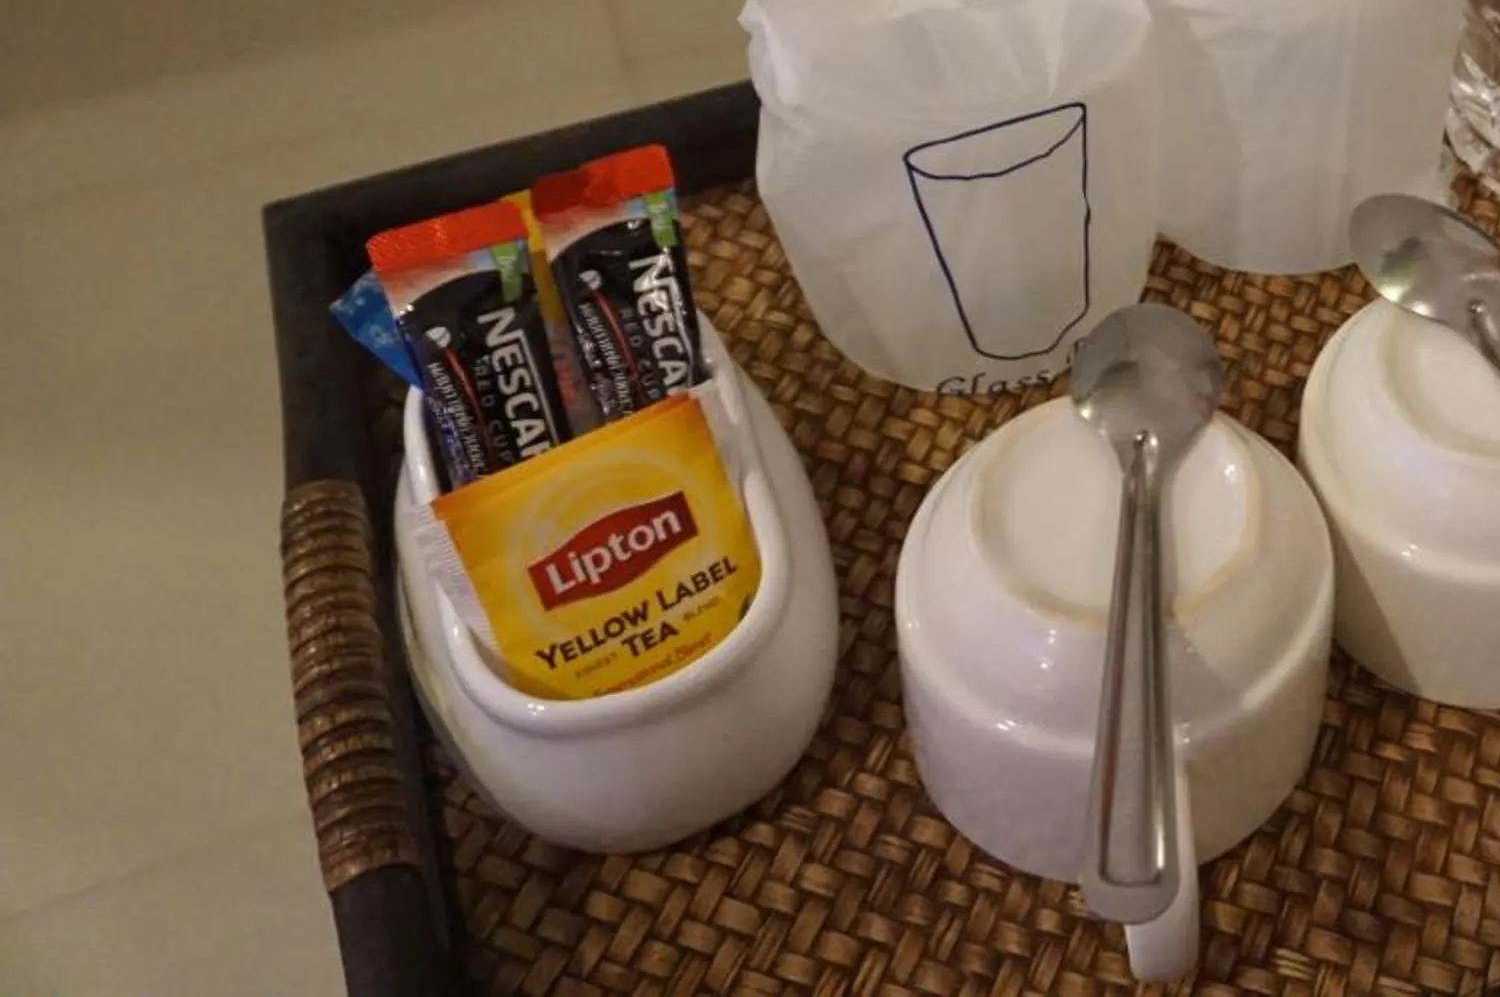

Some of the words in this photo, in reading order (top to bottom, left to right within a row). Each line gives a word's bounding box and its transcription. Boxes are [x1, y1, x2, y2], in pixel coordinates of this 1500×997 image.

[628, 249, 694, 389] NESCA
[477, 306, 559, 457] NESCA
[545, 509, 683, 595] Lipton
[535, 599, 650, 671] YELLOW
[655, 555, 738, 612] LABEL
[621, 620, 680, 659] TEA
